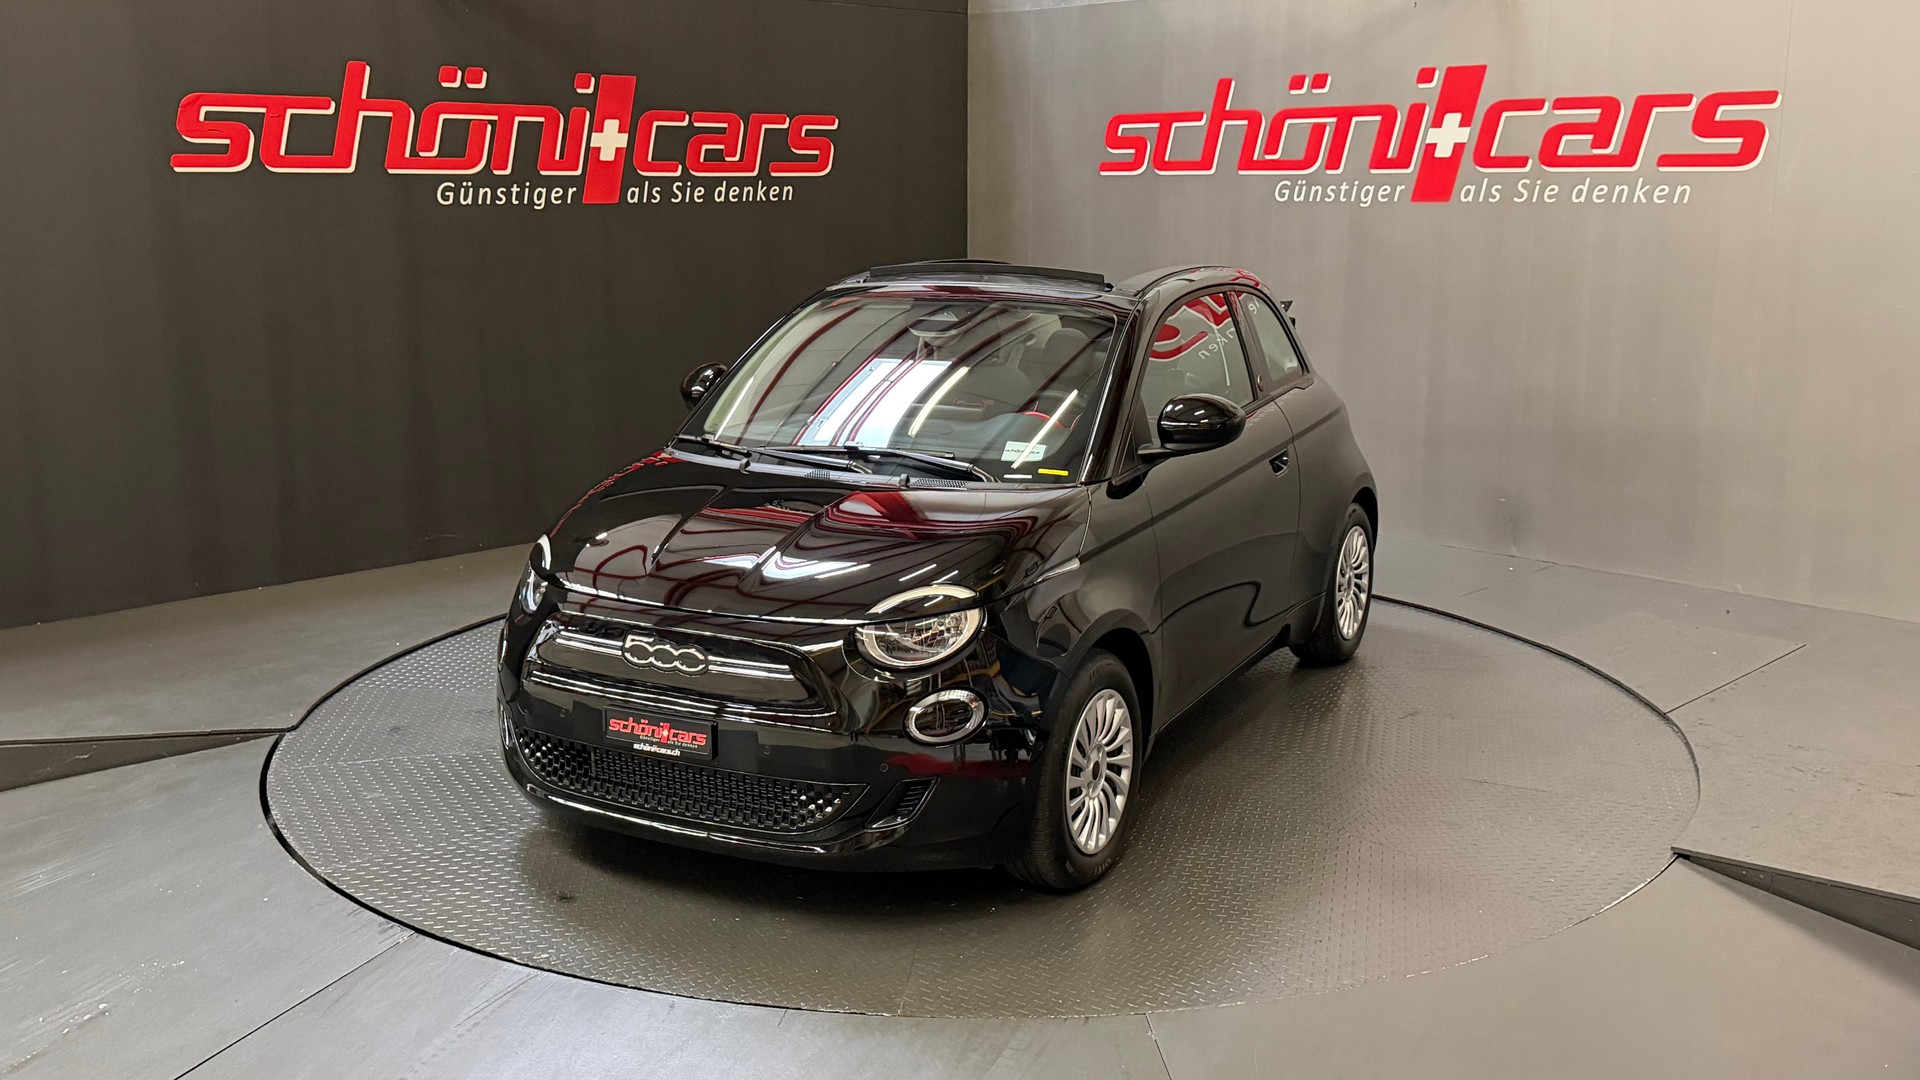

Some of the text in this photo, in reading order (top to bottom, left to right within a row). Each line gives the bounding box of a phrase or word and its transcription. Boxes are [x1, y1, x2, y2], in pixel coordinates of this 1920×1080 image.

[436, 180, 793, 210] Günstiger als Sie denken
[1273, 178, 1692, 207] Günstiger als Sie denken
[624, 634, 706, 672] 500
